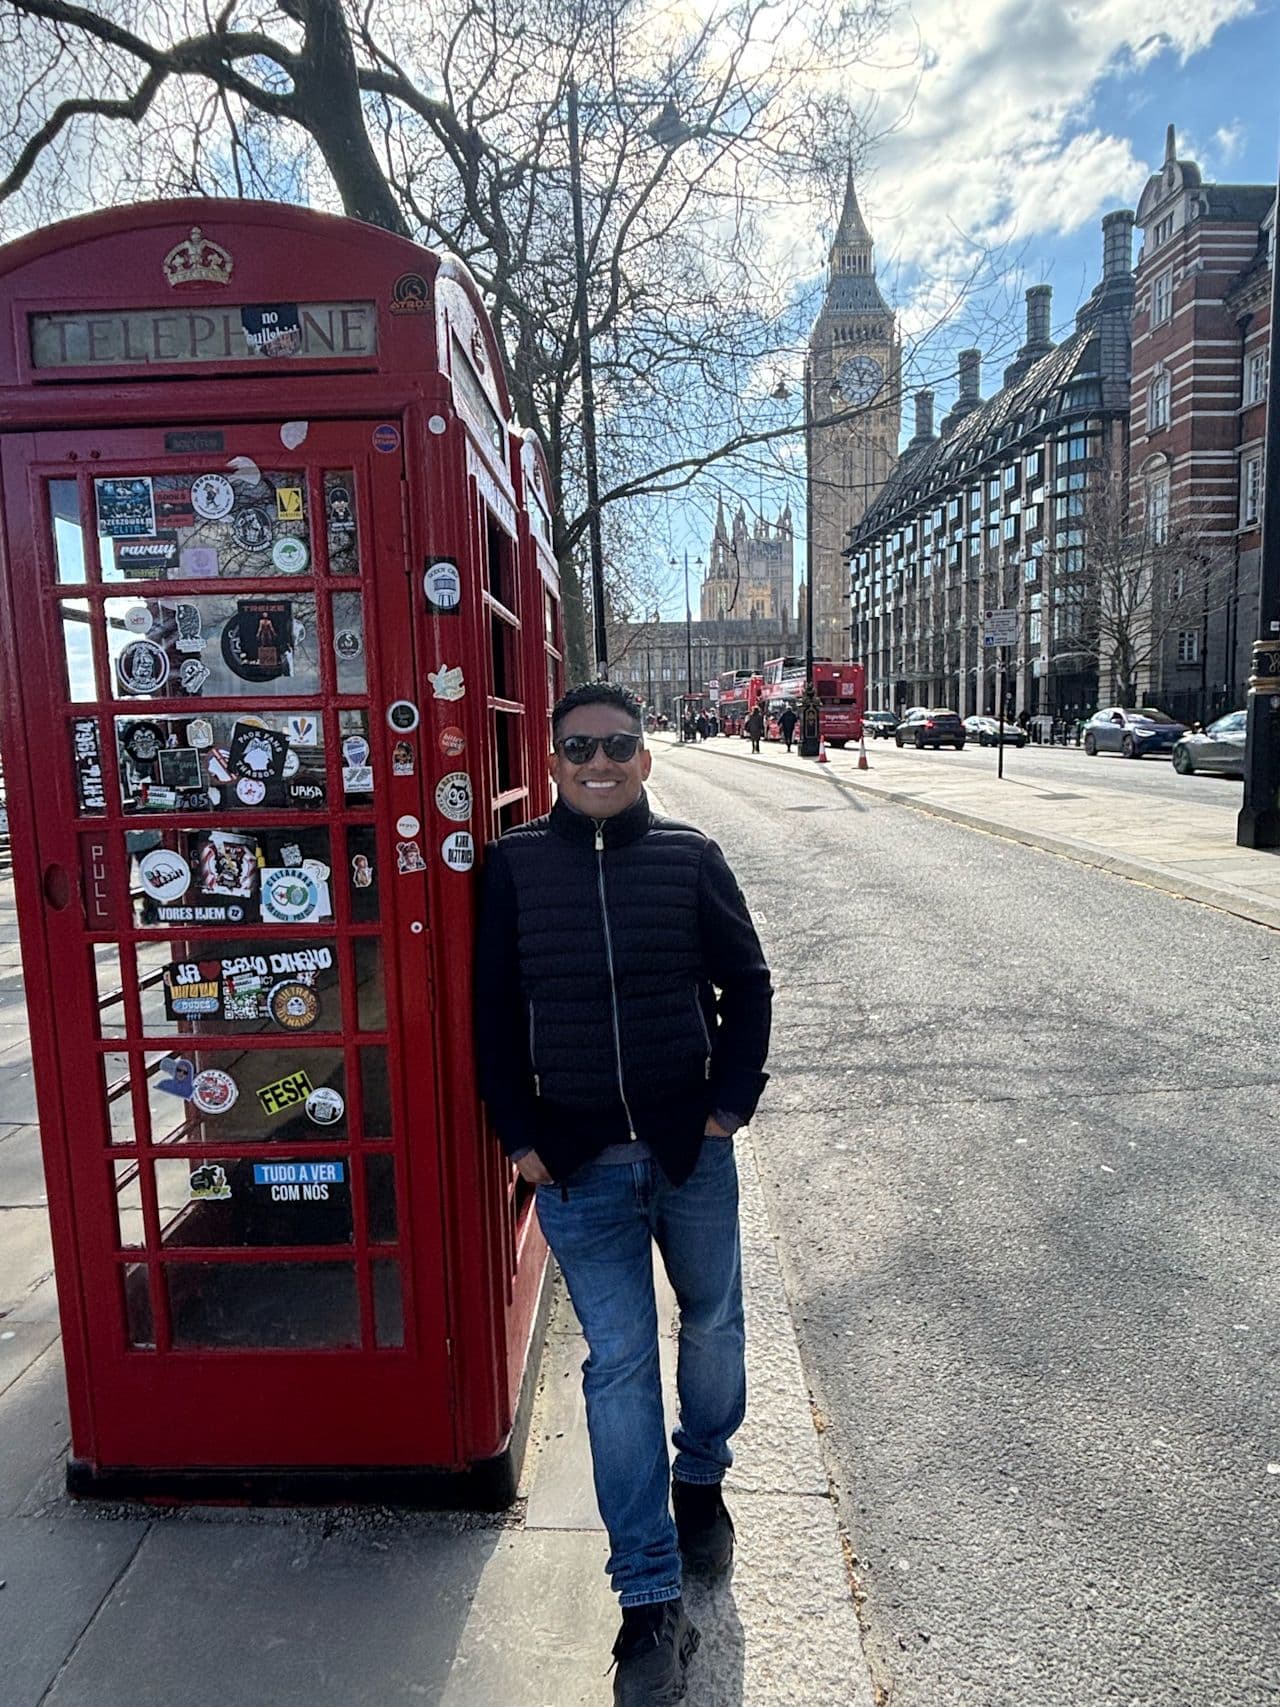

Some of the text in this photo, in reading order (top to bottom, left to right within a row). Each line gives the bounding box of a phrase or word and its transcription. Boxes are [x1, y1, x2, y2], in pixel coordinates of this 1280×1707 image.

[262, 311, 279, 325] no
[48, 308, 369, 362] TELEPHNE
[238, 732, 283, 753] PAOK FANS
[235, 760, 276, 779] THASSOS
[291, 784, 324, 798] URKA
[92, 845, 109, 916] PULL
[157, 906, 193, 921] VORES
[176, 963, 202, 984] JA
[279, 986, 316, 1003] ULTRAS
[276, 1010, 316, 1028] DYNAMO
[262, 1073, 313, 1113] FESH
[261, 1164, 337, 1182] TUDO A VER
[271, 1181, 330, 1202] COM NÓS
